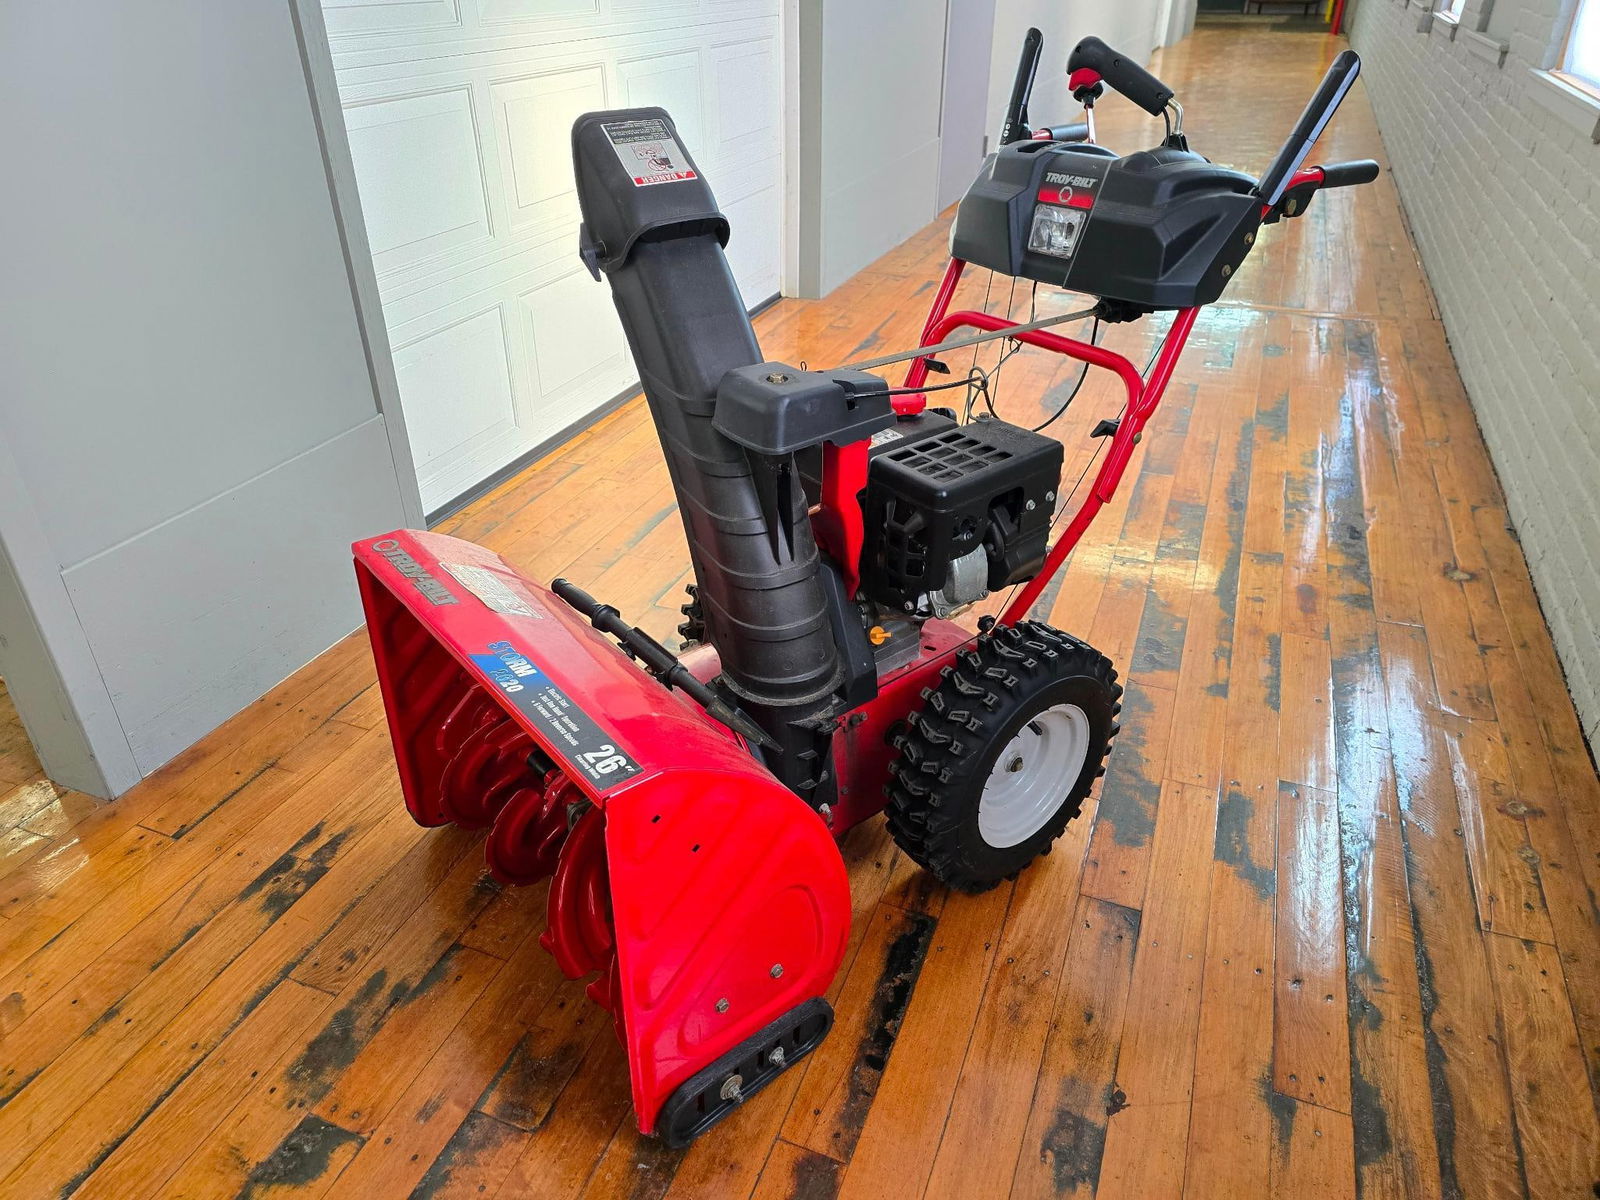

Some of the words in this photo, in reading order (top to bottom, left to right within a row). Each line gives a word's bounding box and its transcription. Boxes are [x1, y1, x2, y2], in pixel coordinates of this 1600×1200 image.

[642, 173, 678, 184] DANGER
[1045, 171, 1098, 188] TROY-BILT
[383, 548, 460, 606] TROY-BILT
[487, 640, 538, 678] STORM
